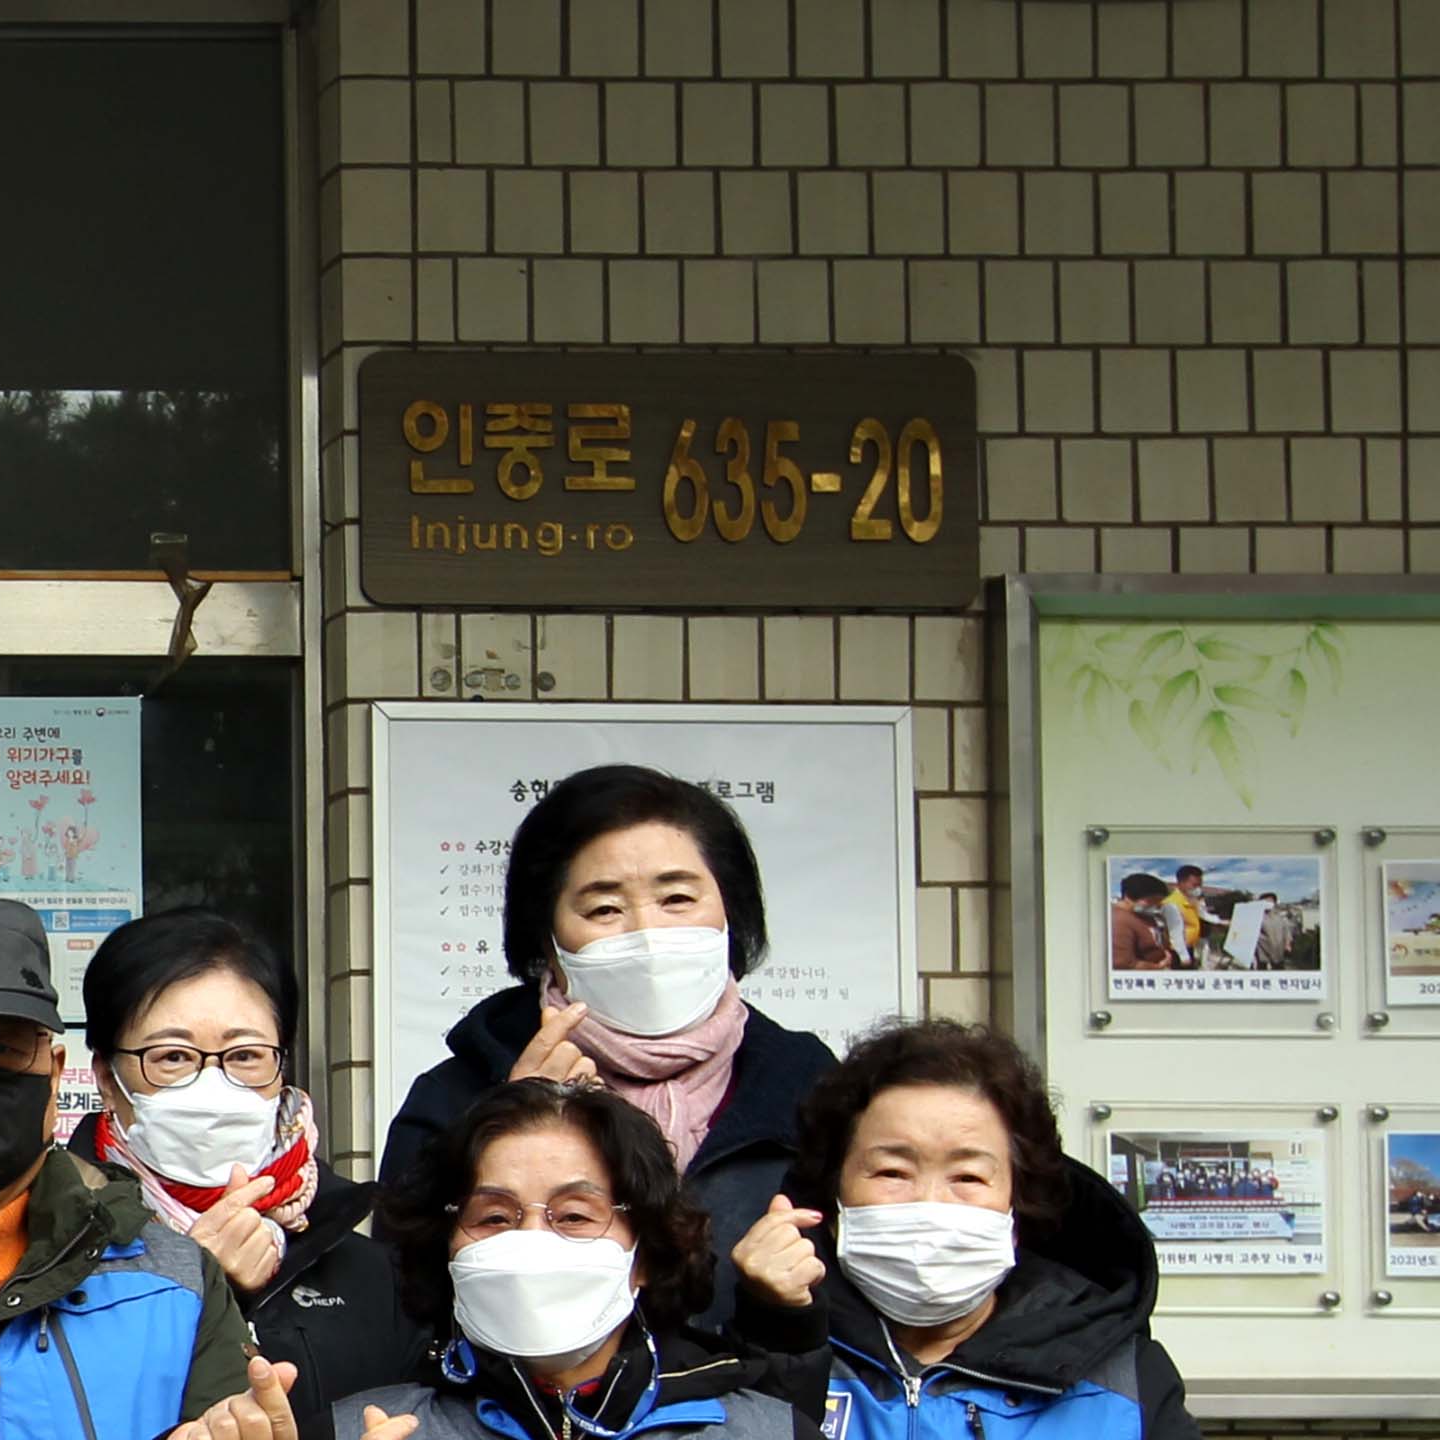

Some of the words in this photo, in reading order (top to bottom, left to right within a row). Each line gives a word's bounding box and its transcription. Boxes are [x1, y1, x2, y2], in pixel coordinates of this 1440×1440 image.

[402, 400, 636, 500] 인중로
[663, 417, 944, 543] 635-20
[23, 727, 61, 743] 주변에
[7, 747, 83, 766] 위기가구를
[6, 769, 91, 790] 알려주세요!
